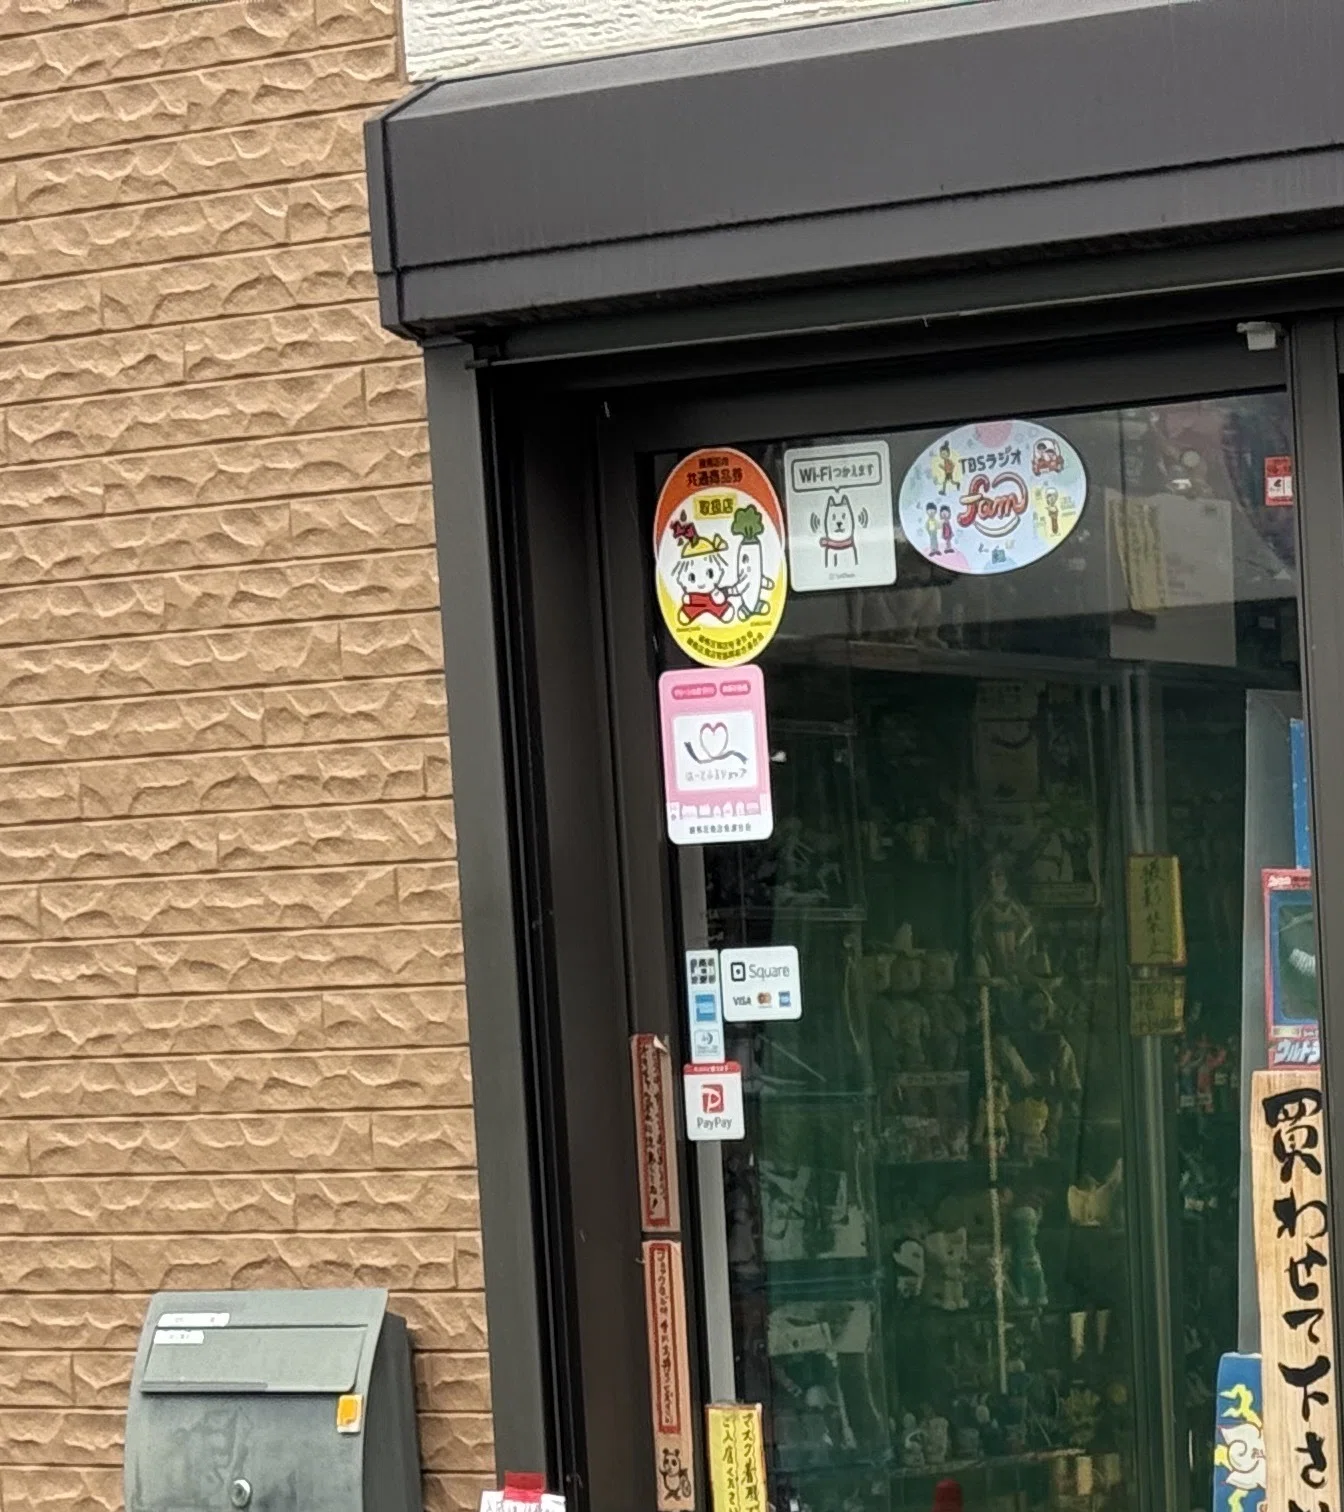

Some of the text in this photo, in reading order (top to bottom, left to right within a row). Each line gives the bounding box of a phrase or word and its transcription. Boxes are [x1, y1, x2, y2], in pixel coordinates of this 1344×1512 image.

[958, 446, 1022, 475] TBSラジオ
[799, 463, 875, 484] Wi-Fiつかえます
[749, 963, 790, 981] Square
[732, 994, 752, 1007] VISA
[696, 1117, 733, 1130] PayPay
